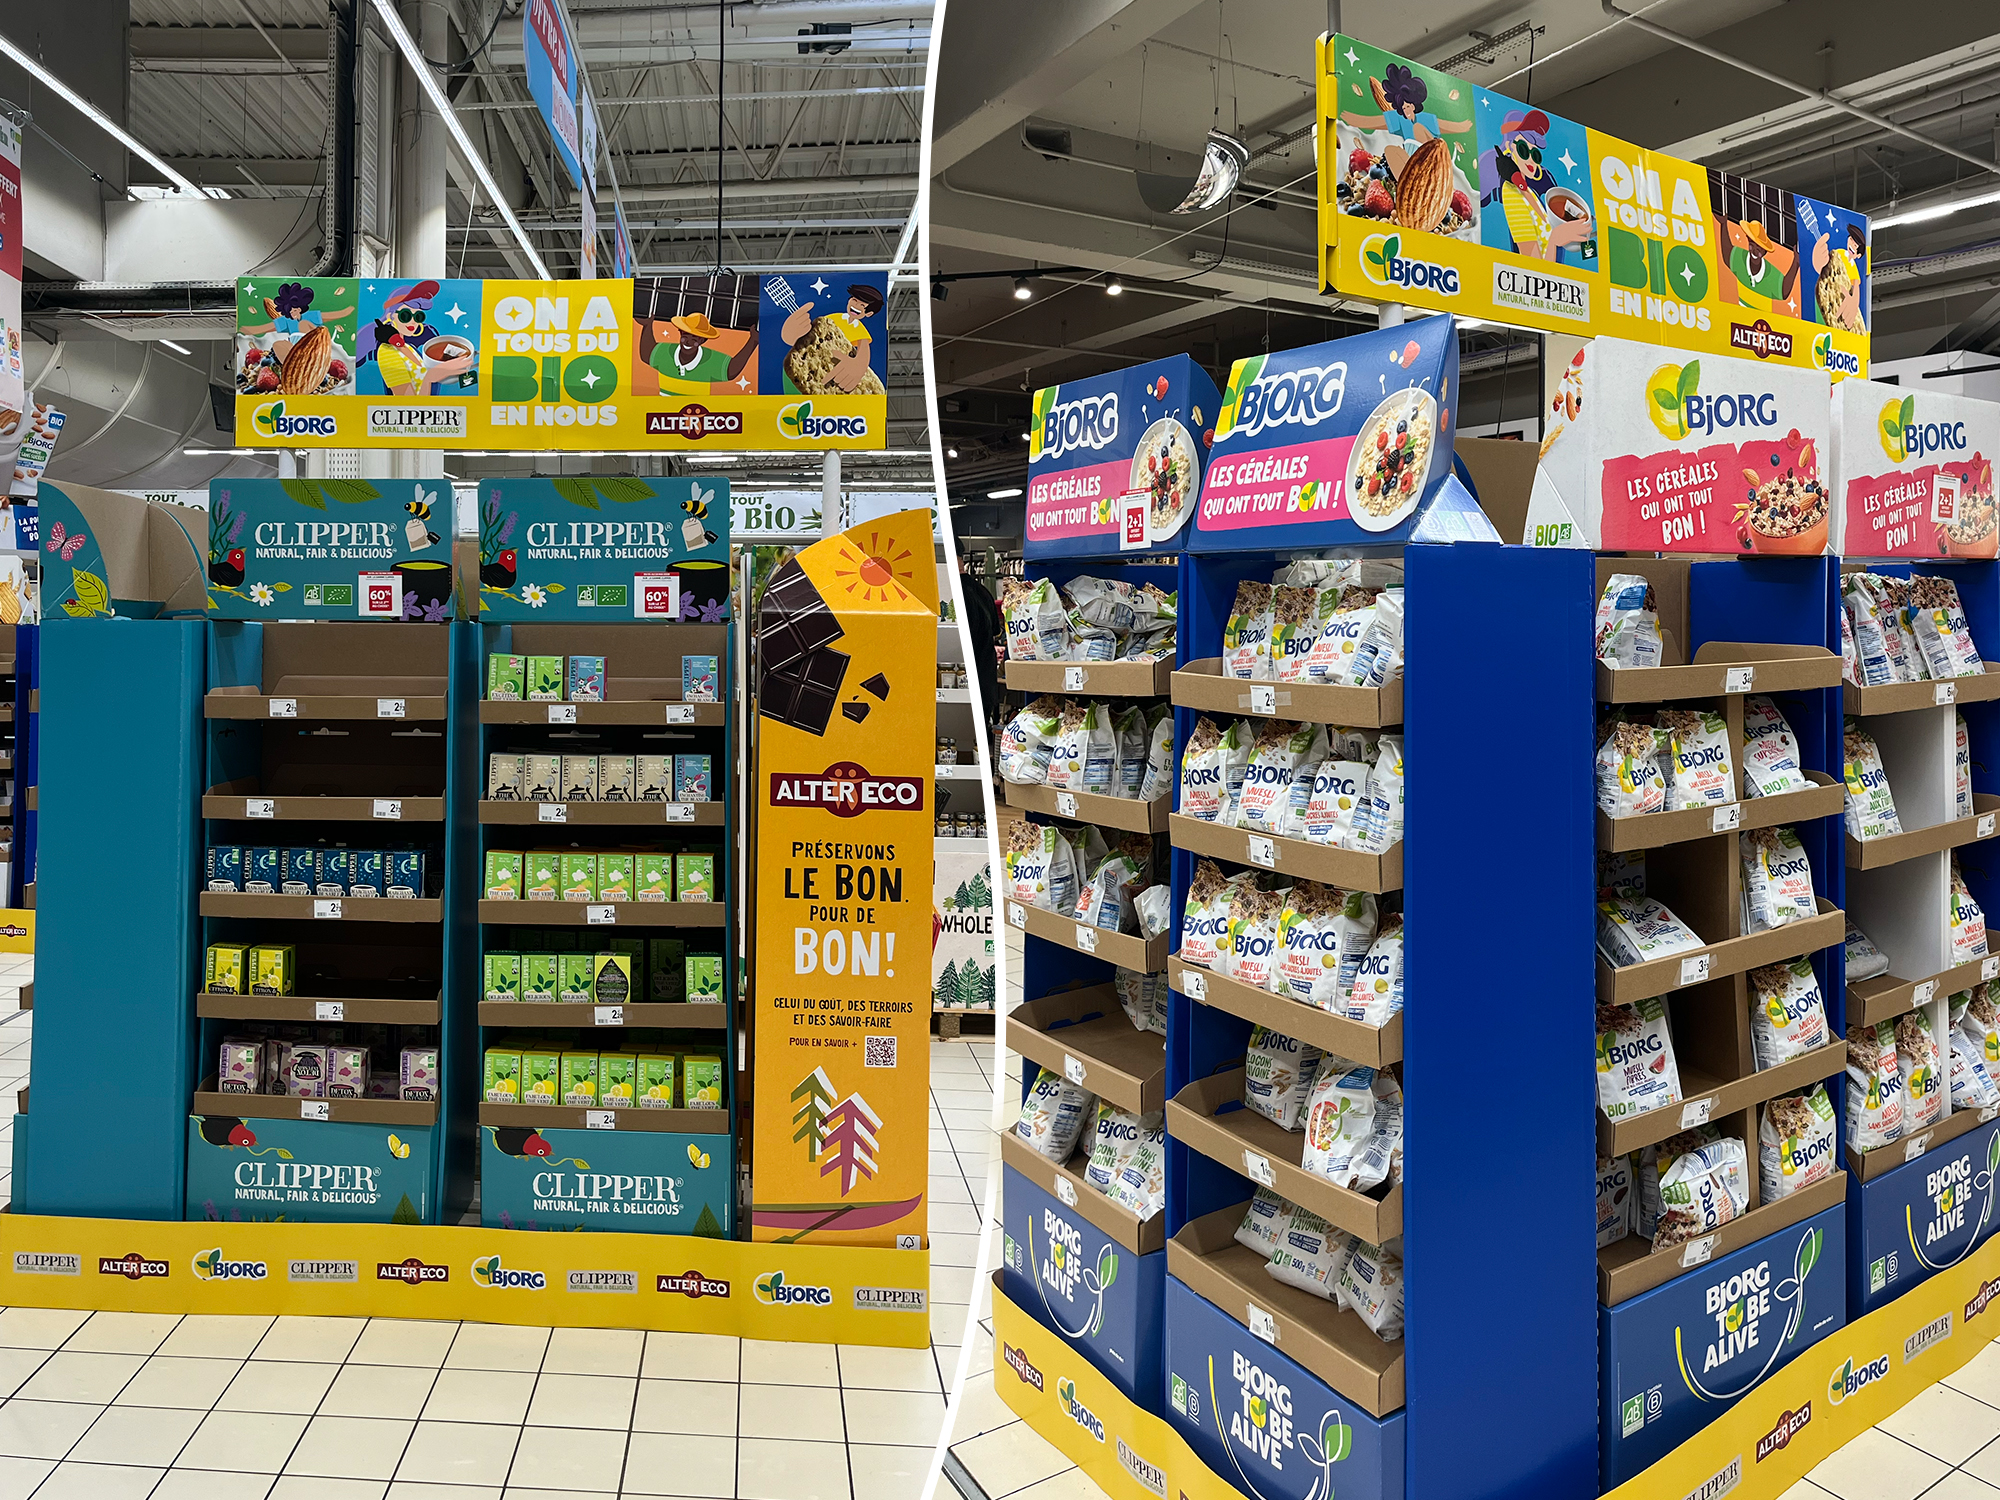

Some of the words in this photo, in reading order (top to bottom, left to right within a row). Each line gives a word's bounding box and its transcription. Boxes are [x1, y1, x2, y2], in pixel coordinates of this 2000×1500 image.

[1600, 155, 1664, 211] ON
[1671, 177, 1703, 222] A
[1603, 197, 1669, 238] TOUS
[1672, 221, 1706, 247] DU
[1608, 225, 1709, 303] BIO
[493, 296, 568, 332] ON
[579, 296, 619, 331] A
[1530, 296, 1545, 309] FAIR
[1551, 301, 1585, 316] DELICIOUS
[1609, 288, 1642, 318] EN
[1646, 296, 1711, 332] NOUS
[493, 332, 571, 353] TOUS
[576, 333, 619, 353] DU
[1732, 328, 1766, 349] ALTER
[1768, 335, 1791, 354] ECO
[491, 355, 618, 403] BIO
[49, 415, 64, 427] BIO
[491, 405, 530, 426] EN
[534, 404, 618, 426] NOUS
[649, 415, 700, 431] ALTER
[703, 415, 739, 431] ECO
[404, 426, 418, 434] FAIR
[425, 426, 461, 434] DELICIOUS
[1209, 465, 1233, 489] LES
[1235, 455, 1310, 485] CÉRÉALES
[1627, 477, 1651, 501] LES
[1656, 460, 1719, 494] CÉRÉALES
[144, 494, 178, 504] TOUT
[731, 496, 764, 506] TOUT
[1031, 481, 1048, 504] LES
[1049, 474, 1101, 501] CÉRÉALES
[1863, 493, 1881, 515] LES
[1884, 479, 1928, 505] CÉRÉALES
[1938, 492, 1953, 508] 2+1
[1203, 497, 1225, 520] QUI
[1225, 495, 1250, 514] ONT
[1251, 492, 1284, 512] TOUT
[1640, 501, 1661, 522] QUI
[1664, 494, 1687, 513] ONT
[1688, 487, 1713, 508] TOUT
[1872, 515, 1886, 531] QUI
[1888, 508, 1903, 525] ONT
[1906, 501, 1923, 519] TOUT
[1029, 511, 1045, 531] QUI
[1045, 510, 1062, 527] ONT
[1064, 507, 1088, 525] TOUT
[1127, 513, 1144, 530] 2+1
[1661, 515, 1696, 546] BON
[1535, 524, 1559, 547] BIO
[1886, 526, 1908, 552] BON
[255, 547, 304, 561] NATURAL,
[306, 547, 327, 559] FAIR
[340, 548, 393, 559] DELICIOUS
[528, 548, 577, 561] NATURAL,
[580, 548, 602, 559] FAIR
[615, 548, 669, 559] DELICIOUS
[369, 589, 391, 601] 60%
[645, 590, 668, 602] 60%
[775, 780, 855, 803] ALTER
[861, 781, 918, 805] ECO
[792, 839, 896, 861] PRÉSERVONS
[784, 867, 820, 899] LE
[809, 905, 849, 923] POUR
[856, 907, 876, 924] DE
[941, 914, 993, 935] WHOLE
[774, 997, 801, 1010] CELUI
[803, 998, 816, 1010] DU
[818, 997, 844, 1013] GOÛT,
[847, 1000, 866, 1011] DES
[868, 1000, 913, 1013] TERROIRS
[793, 1014, 805, 1026] ET
[807, 1014, 826, 1026] DES
[828, 1015, 892, 1029] SAVOIR-FAIRE
[789, 1037, 809, 1047] POUR
[811, 1038, 821, 1048] EN
[824, 1038, 850, 1048] SAVOIR
[1607, 1102, 1626, 1118] BIO
[235, 1188, 284, 1202] NATURAL,
[287, 1190, 309, 1202] FAIR
[322, 1192, 377, 1204] DELICIOUS
[1955, 1178, 1972, 1206] BE
[533, 1199, 585, 1214] NATURAL,
[587, 1201, 610, 1213] FAIR
[623, 1203, 679, 1215] DELICIOUS
[1925, 1205, 1965, 1246] ALIVE
[101, 1260, 137, 1274] ALTER
[140, 1262, 167, 1275] ECO
[659, 1279, 698, 1294] ALTER
[700, 1283, 728, 1296] ECO
[1747, 1287, 1770, 1323] BE
[1965, 1292, 1986, 1319] ALTER
[1703, 1320, 1759, 1374] ALIVE
[1004, 1346, 1026, 1379] ALTER
[1025, 1365, 1043, 1389] ECO
[1230, 1410, 1283, 1472] ALIVE
[1269, 1408, 1294, 1450] BE
[1758, 1425, 1787, 1458] ALTER
[1789, 1407, 1810, 1433] ECO
